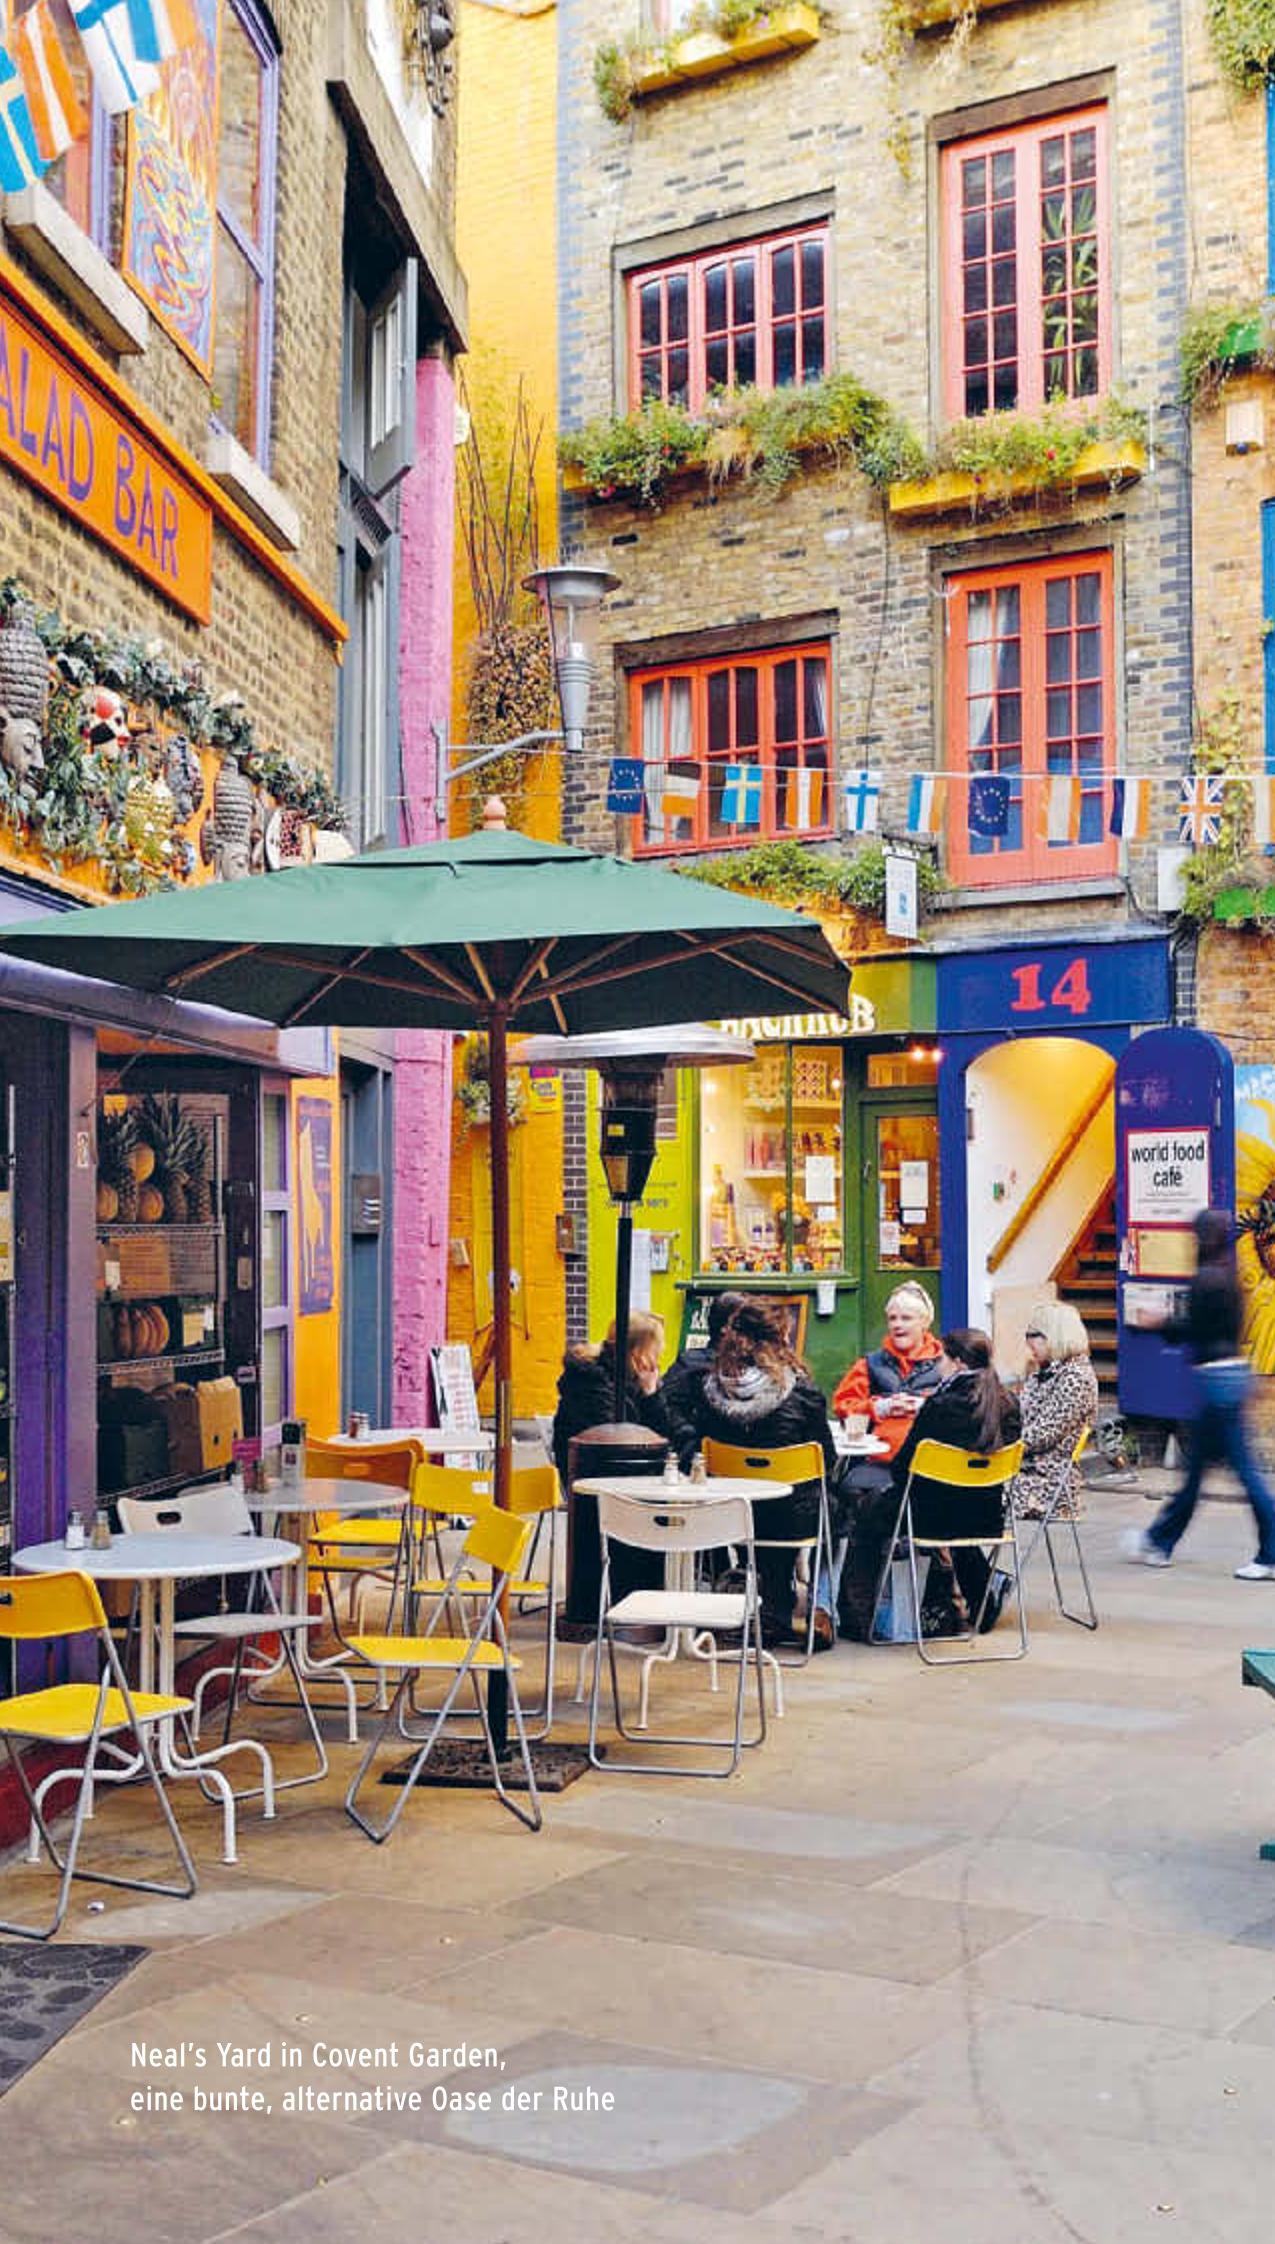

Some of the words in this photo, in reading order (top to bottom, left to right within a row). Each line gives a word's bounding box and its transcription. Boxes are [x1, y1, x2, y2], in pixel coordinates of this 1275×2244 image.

[114, 433, 179, 579] BAR
[1011, 957, 1092, 1014] 14
[1131, 1141, 1169, 1162] world
[1173, 1139, 1205, 1161] food
